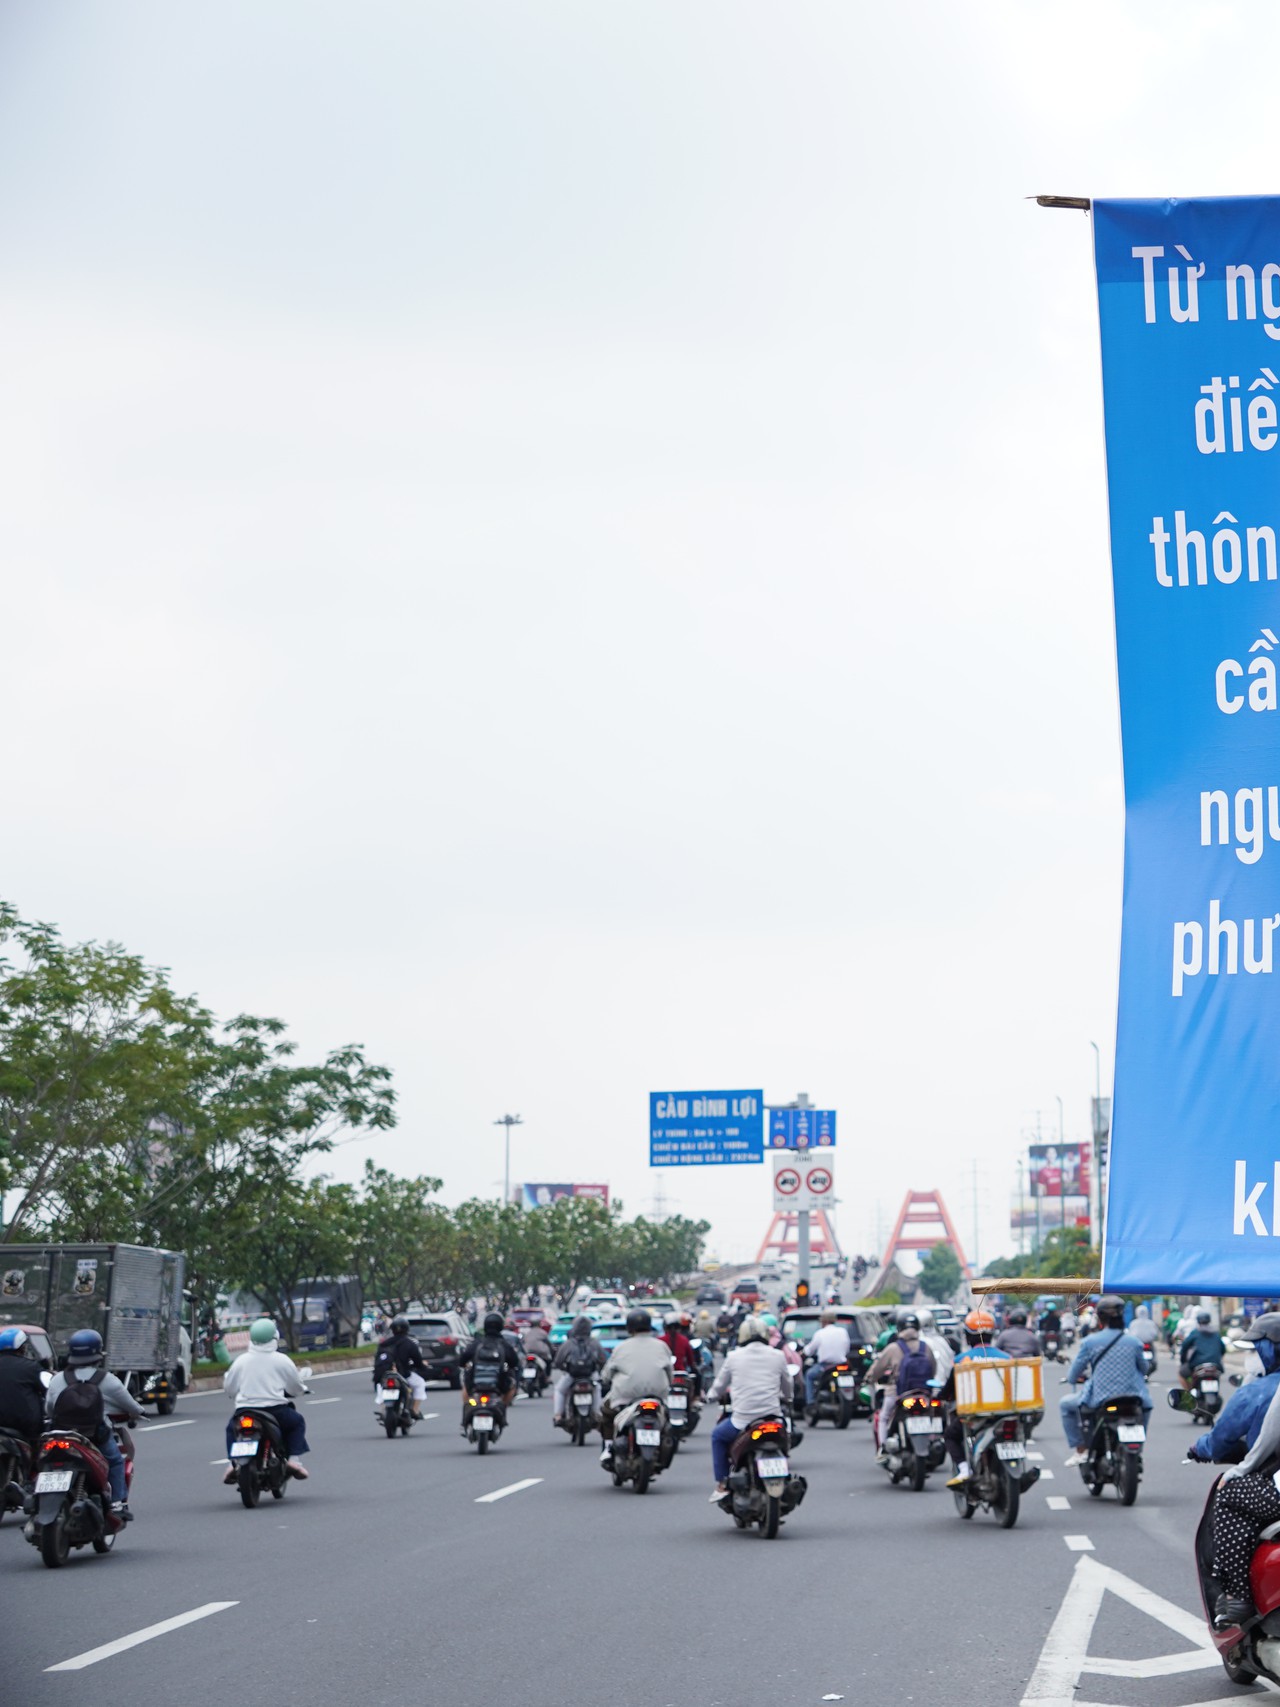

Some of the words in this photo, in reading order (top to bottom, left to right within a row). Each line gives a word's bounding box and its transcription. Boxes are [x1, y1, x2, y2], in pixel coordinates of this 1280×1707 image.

[1131, 245, 1207, 324] Từ
[655, 1093, 689, 1119] CẦU
[692, 1094, 728, 1119] BÌNH
[732, 1095, 757, 1120] LỢI
